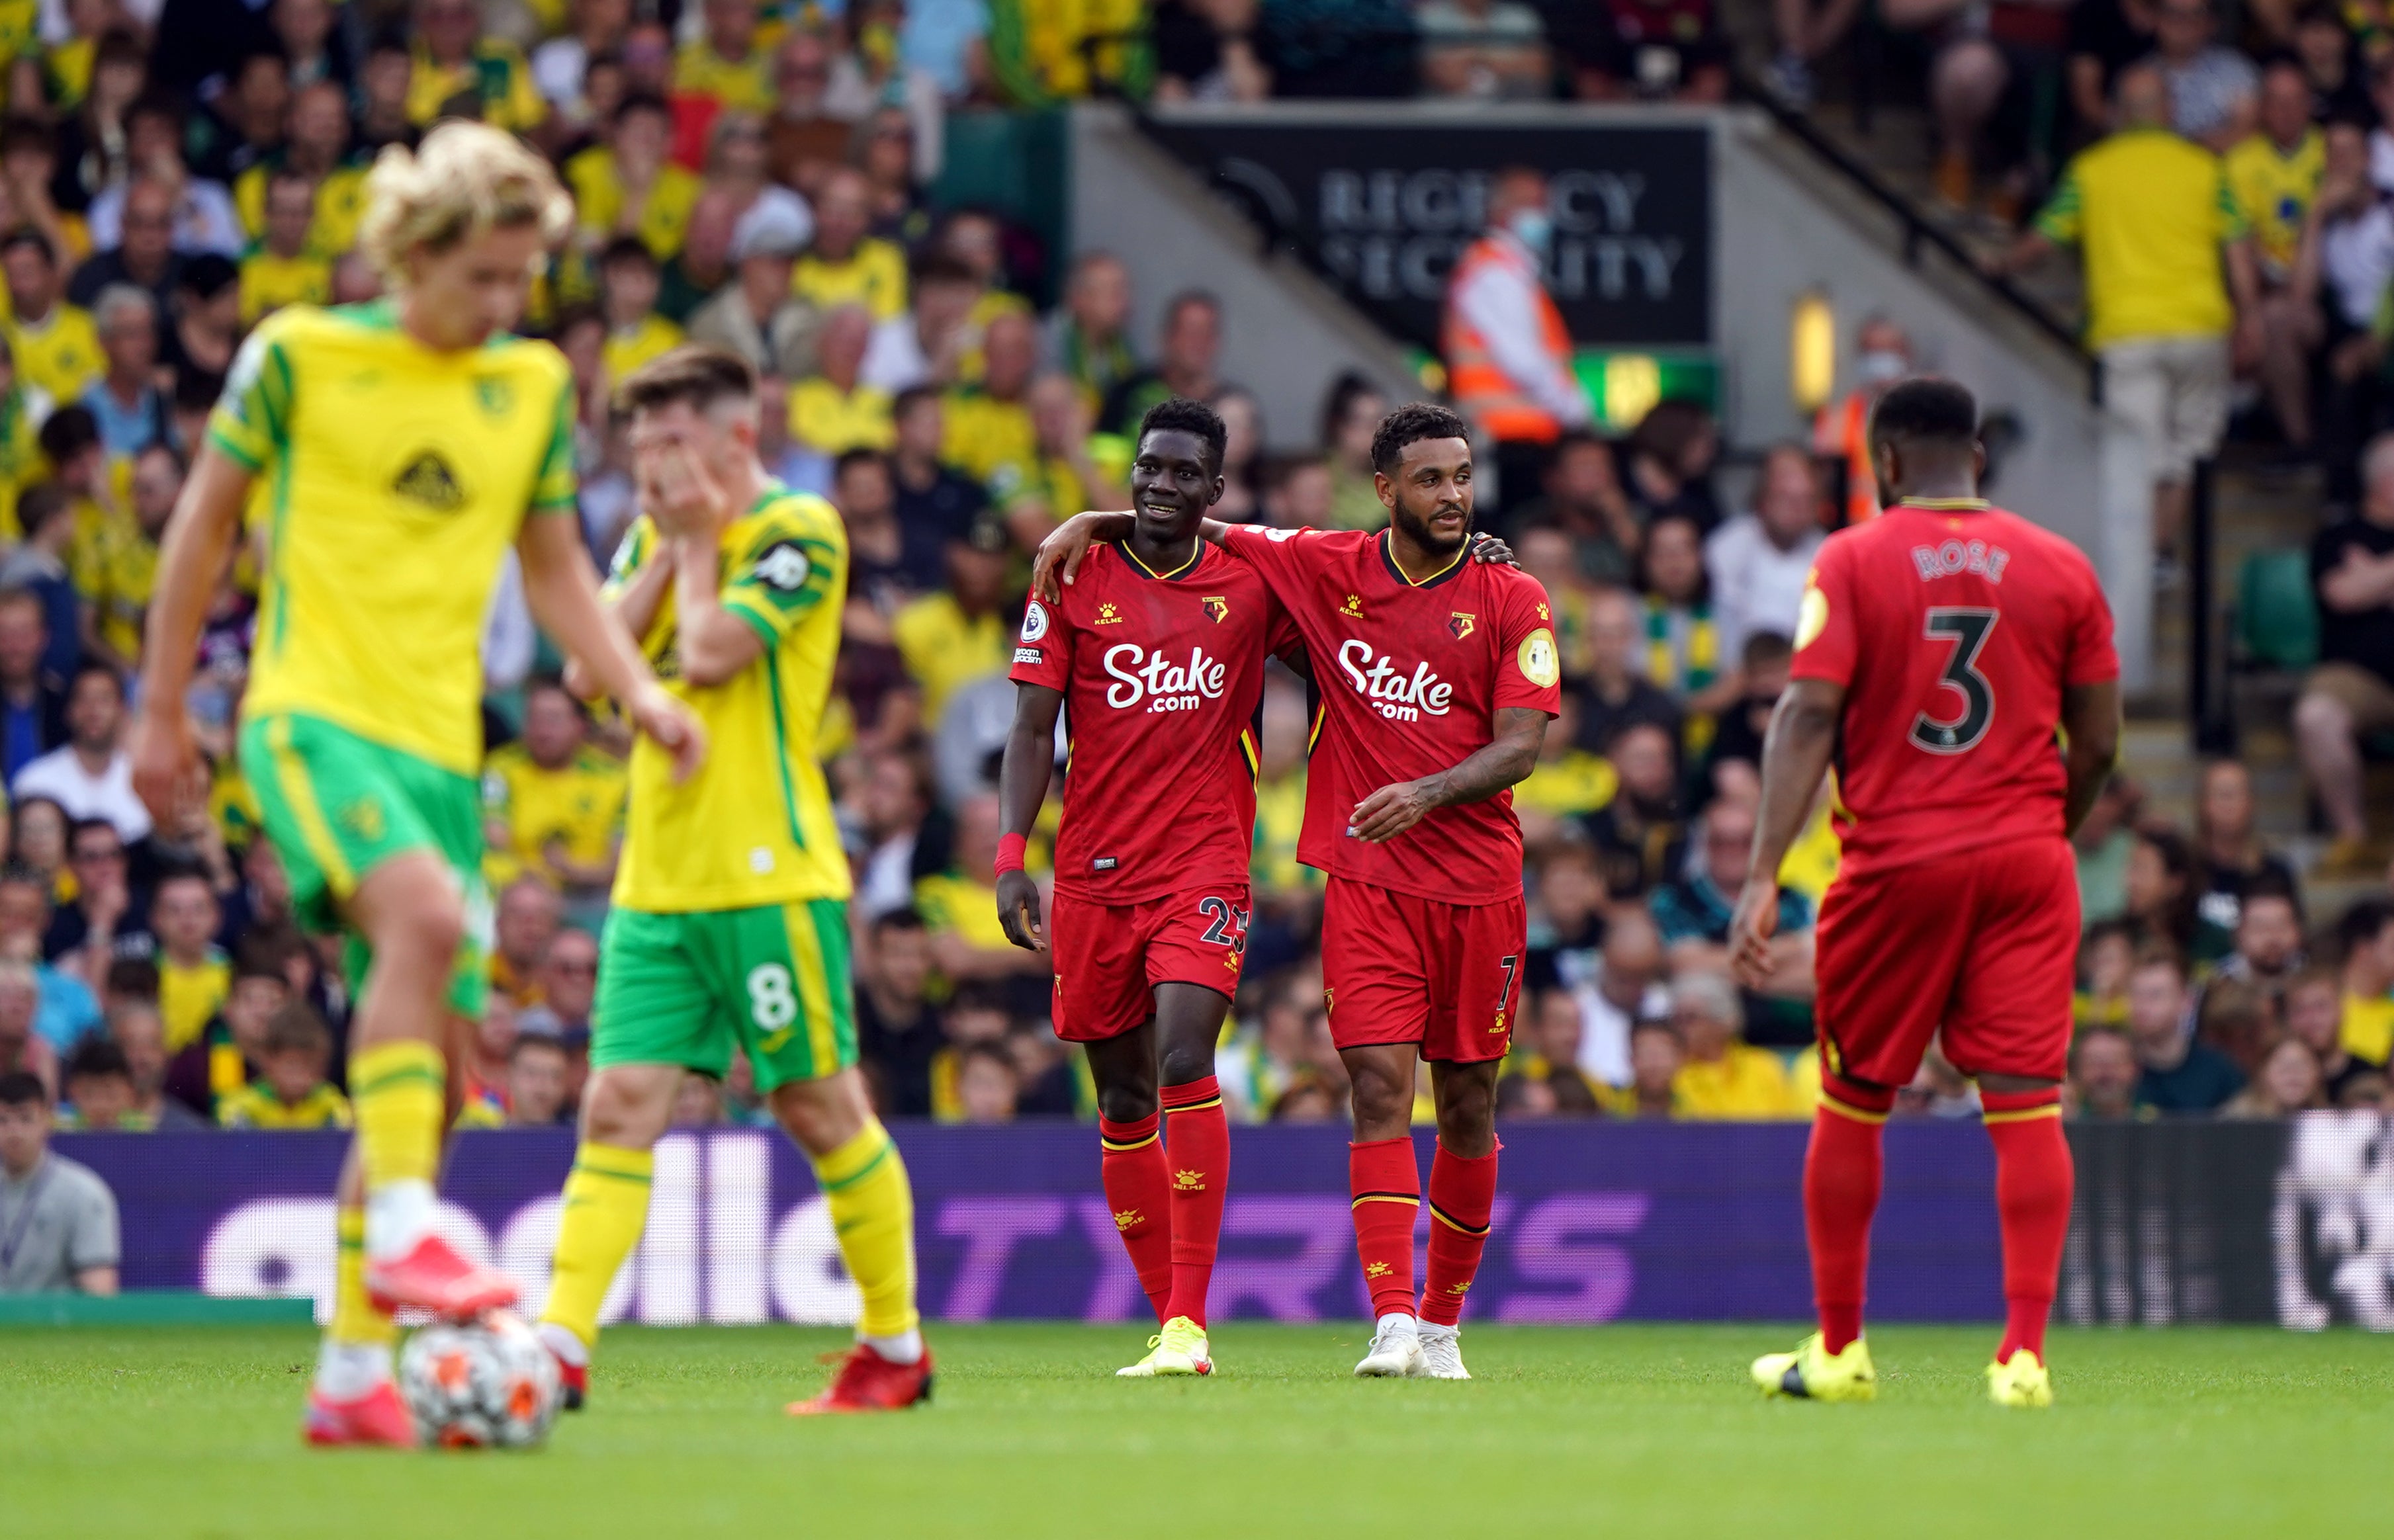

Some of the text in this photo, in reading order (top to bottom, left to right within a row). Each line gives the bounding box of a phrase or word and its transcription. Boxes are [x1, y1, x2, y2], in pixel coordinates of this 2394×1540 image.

[1910, 538, 2010, 585] ROSE
[1094, 617, 1123, 625] KELME
[1339, 607, 1364, 619] KELME
[1104, 644, 1225, 708] Stake
[1147, 695, 1200, 713] .com
[1338, 639, 1452, 715] Stake
[1908, 605, 2000, 755] 3
[746, 961, 798, 1032] 8
[1496, 955, 1518, 1011] 7
